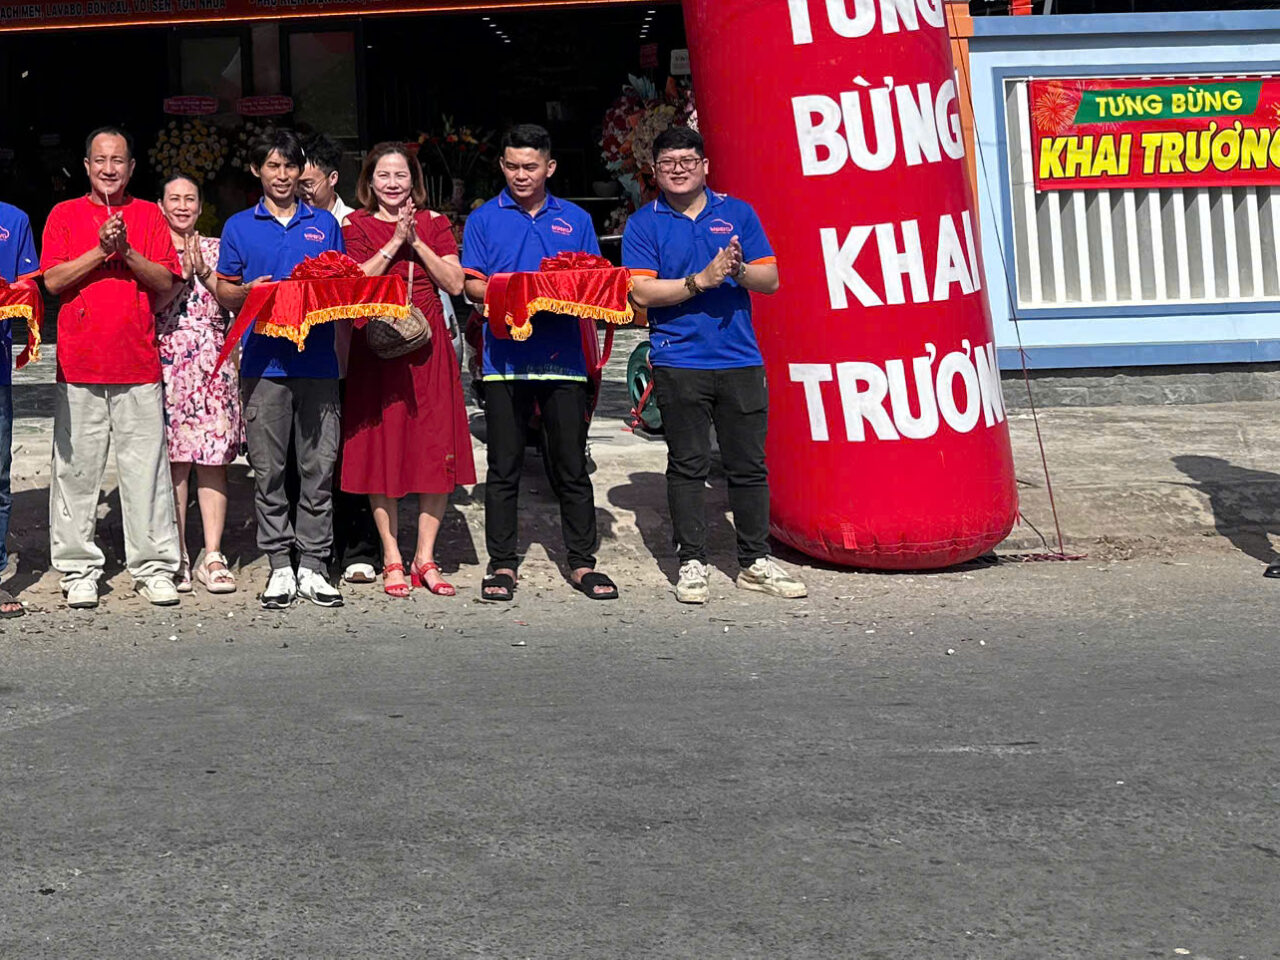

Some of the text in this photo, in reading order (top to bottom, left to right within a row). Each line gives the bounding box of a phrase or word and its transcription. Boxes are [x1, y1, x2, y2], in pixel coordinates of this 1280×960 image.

[791, 75, 964, 176] BỪNG
[1096, 87, 1243, 117] TƯNG BỪNG
[1039, 134, 1133, 180] KHAI
[820, 210, 982, 310] KHAI
[788, 338, 1005, 442] TRƯƠN
